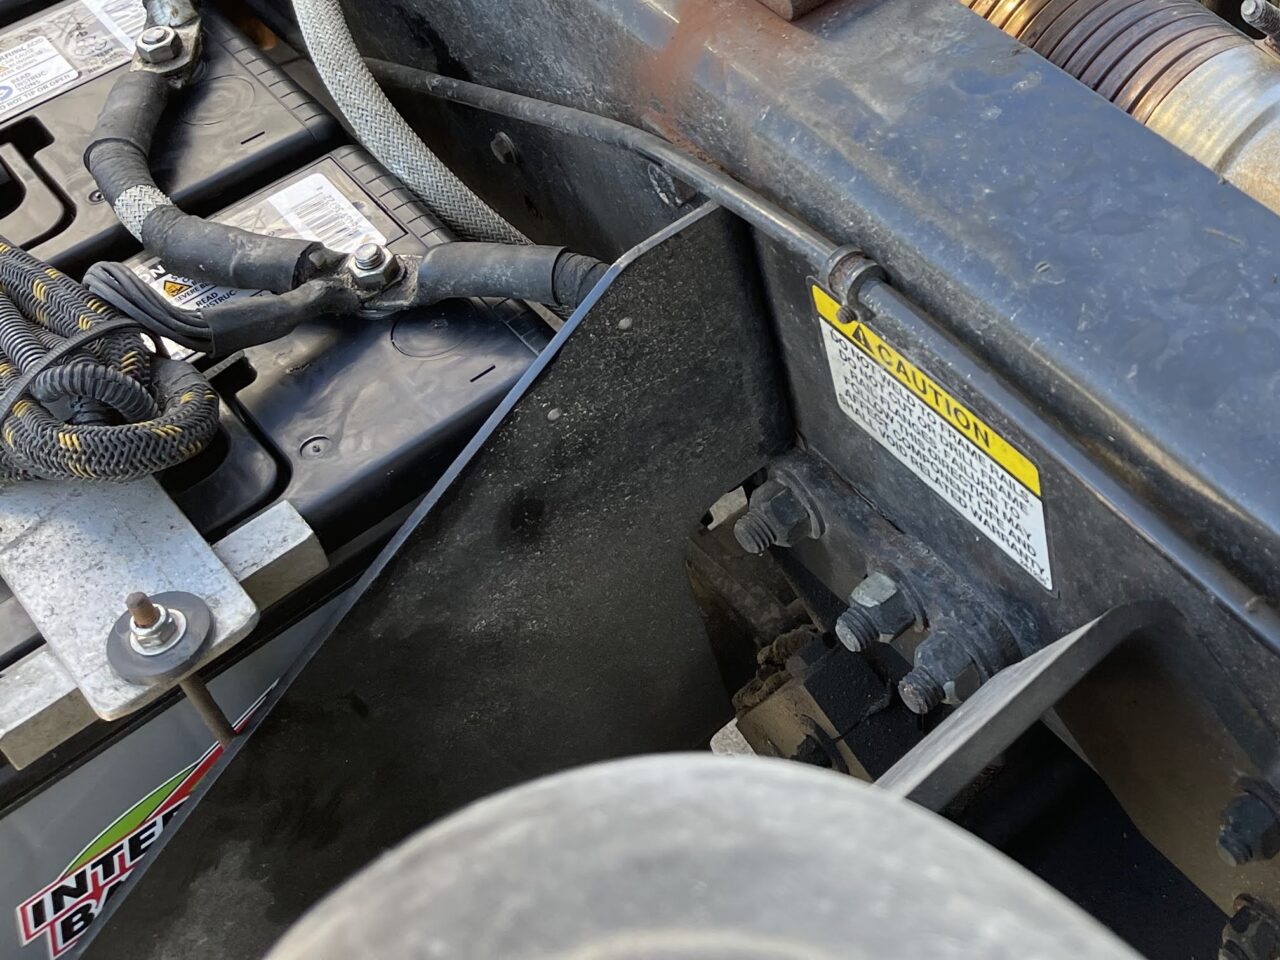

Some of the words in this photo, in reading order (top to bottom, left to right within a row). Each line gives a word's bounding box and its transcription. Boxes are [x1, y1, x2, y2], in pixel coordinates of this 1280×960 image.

[195, 292, 219, 307] READ
[829, 328, 848, 353] DO
[850, 345, 876, 376] NOT
[879, 370, 916, 409] WELD
[917, 402, 937, 427] TO
[939, 420, 987, 469] FRAME
[837, 390, 877, 433] SHALL
[877, 425, 908, 460] VOID
[909, 452, 968, 512] RELATED
[838, 347, 857, 372] DO
[858, 364, 885, 395] NOT
[887, 388, 915, 421] CUT
[916, 413, 936, 438] OR
[938, 432, 978, 474] DRILL
[979, 466, 1029, 516] FRAME
[843, 373, 895, 426] FOLLOW
[896, 418, 926, 453] THIS
[1001, 508, 1033, 544] MAY
[848, 367, 878, 400] RAIL
[942, 446, 999, 503] FAILURE
[1000, 495, 1020, 522] TO
[876, 341, 990, 449] CAUTION
[842, 384, 889, 432] AFFECT
[891, 426, 973, 504] COMPONENT
[976, 498, 1005, 532] LIFE
[1007, 525, 1037, 559] AND
